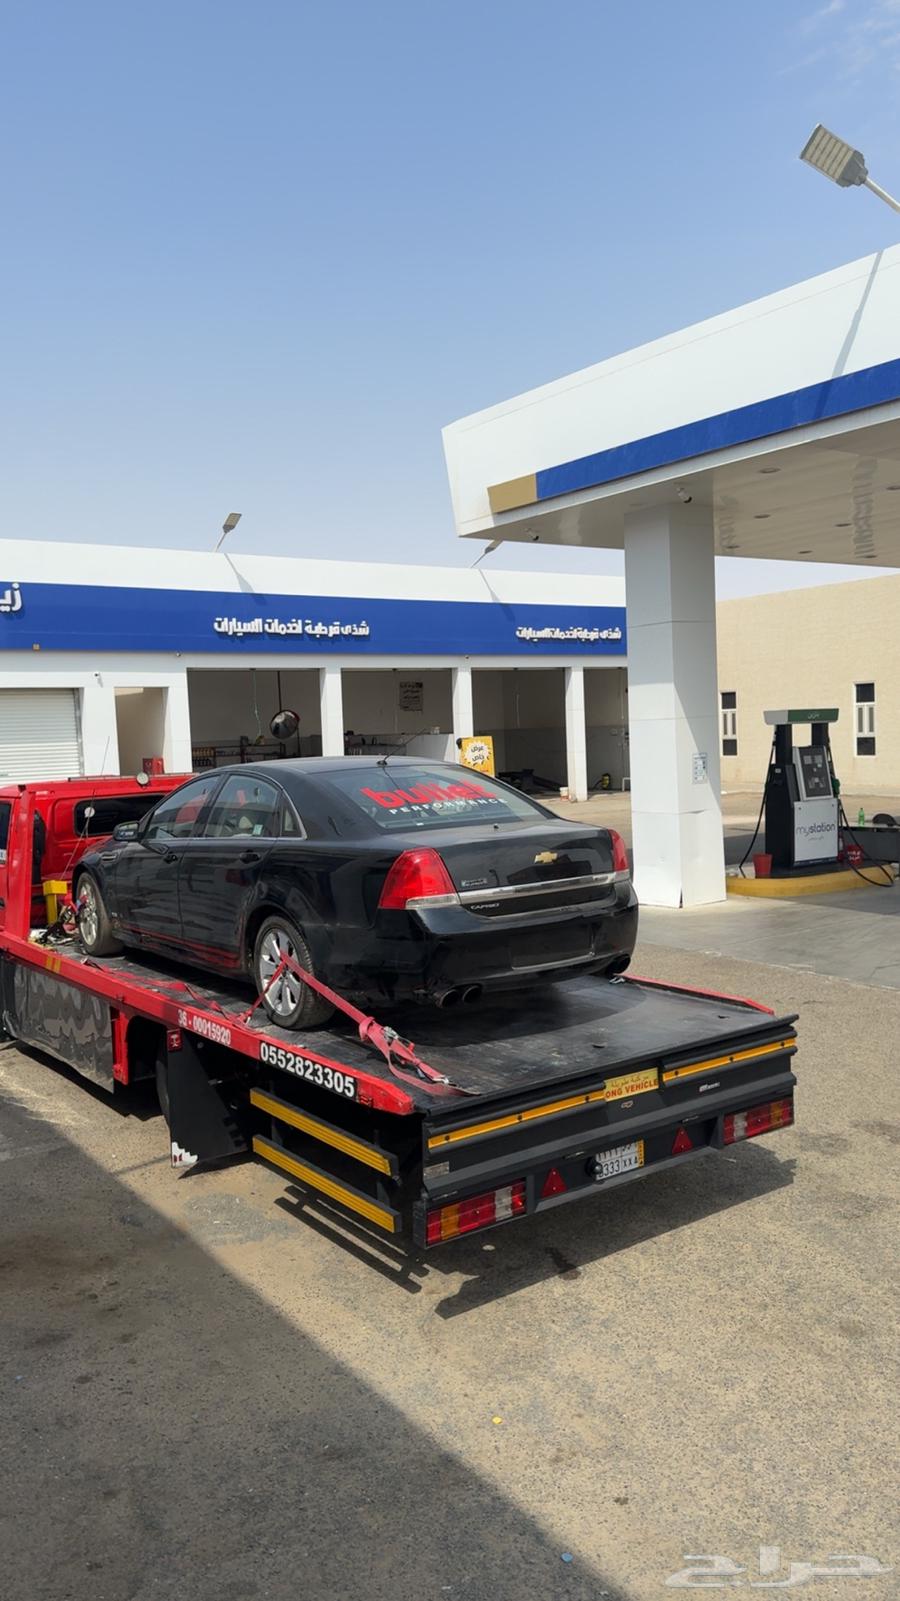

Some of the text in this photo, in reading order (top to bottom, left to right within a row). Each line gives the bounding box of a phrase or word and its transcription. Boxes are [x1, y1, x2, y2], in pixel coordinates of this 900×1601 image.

[213, 617, 263, 636] السيارات
[360, 779, 497, 809] bullet
[389, 798, 508, 815] PERFORMANCE
[796, 822, 836, 837] mystation
[260, 1042, 355, 1098] 0552823305
[605, 1078, 659, 1099] ONG VEHICLE
